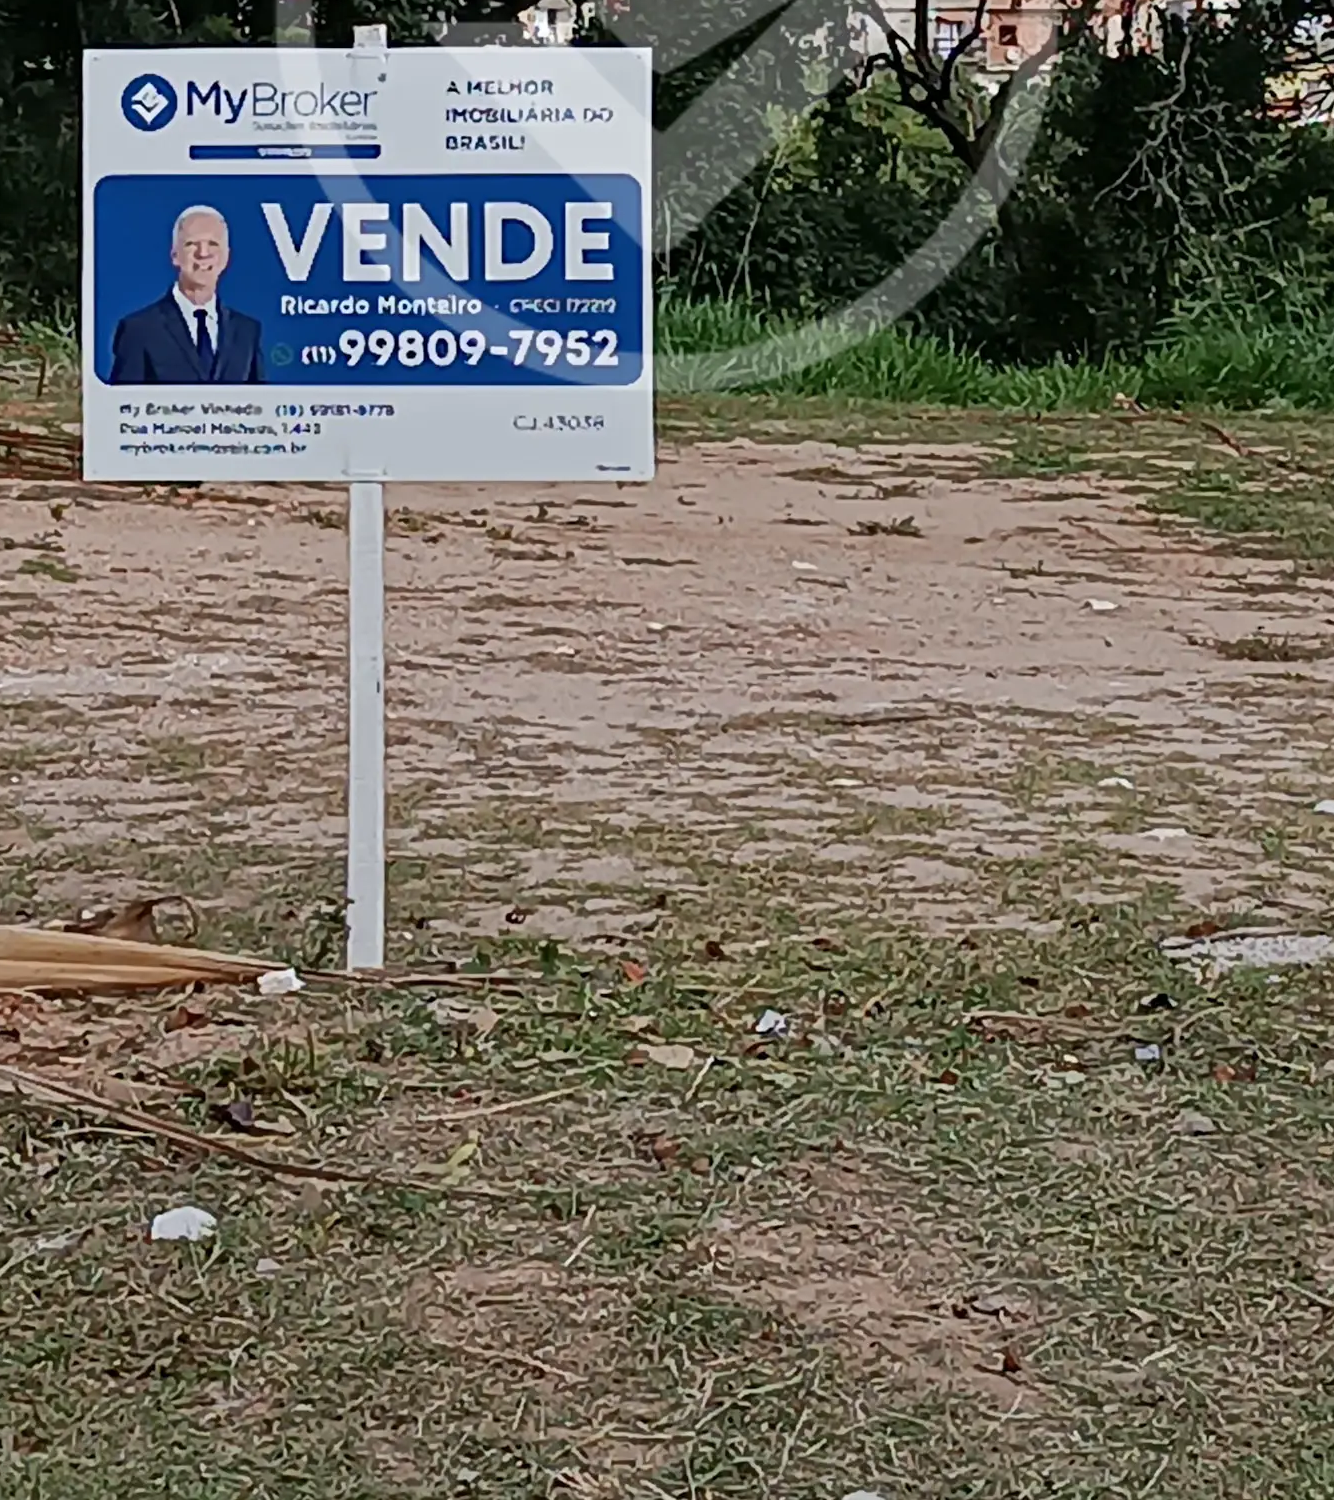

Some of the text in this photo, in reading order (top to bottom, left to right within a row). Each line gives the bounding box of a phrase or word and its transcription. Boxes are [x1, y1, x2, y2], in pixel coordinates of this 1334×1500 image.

[186, 80, 378, 124] MyBroker
[446, 80, 554, 95] A MELHOR
[583, 108, 614, 123] DO
[261, 202, 615, 282] VENDE
[281, 295, 370, 315] Ricardo
[378, 295, 482, 315] Monteiro
[338, 329, 620, 367] 99809-7952
